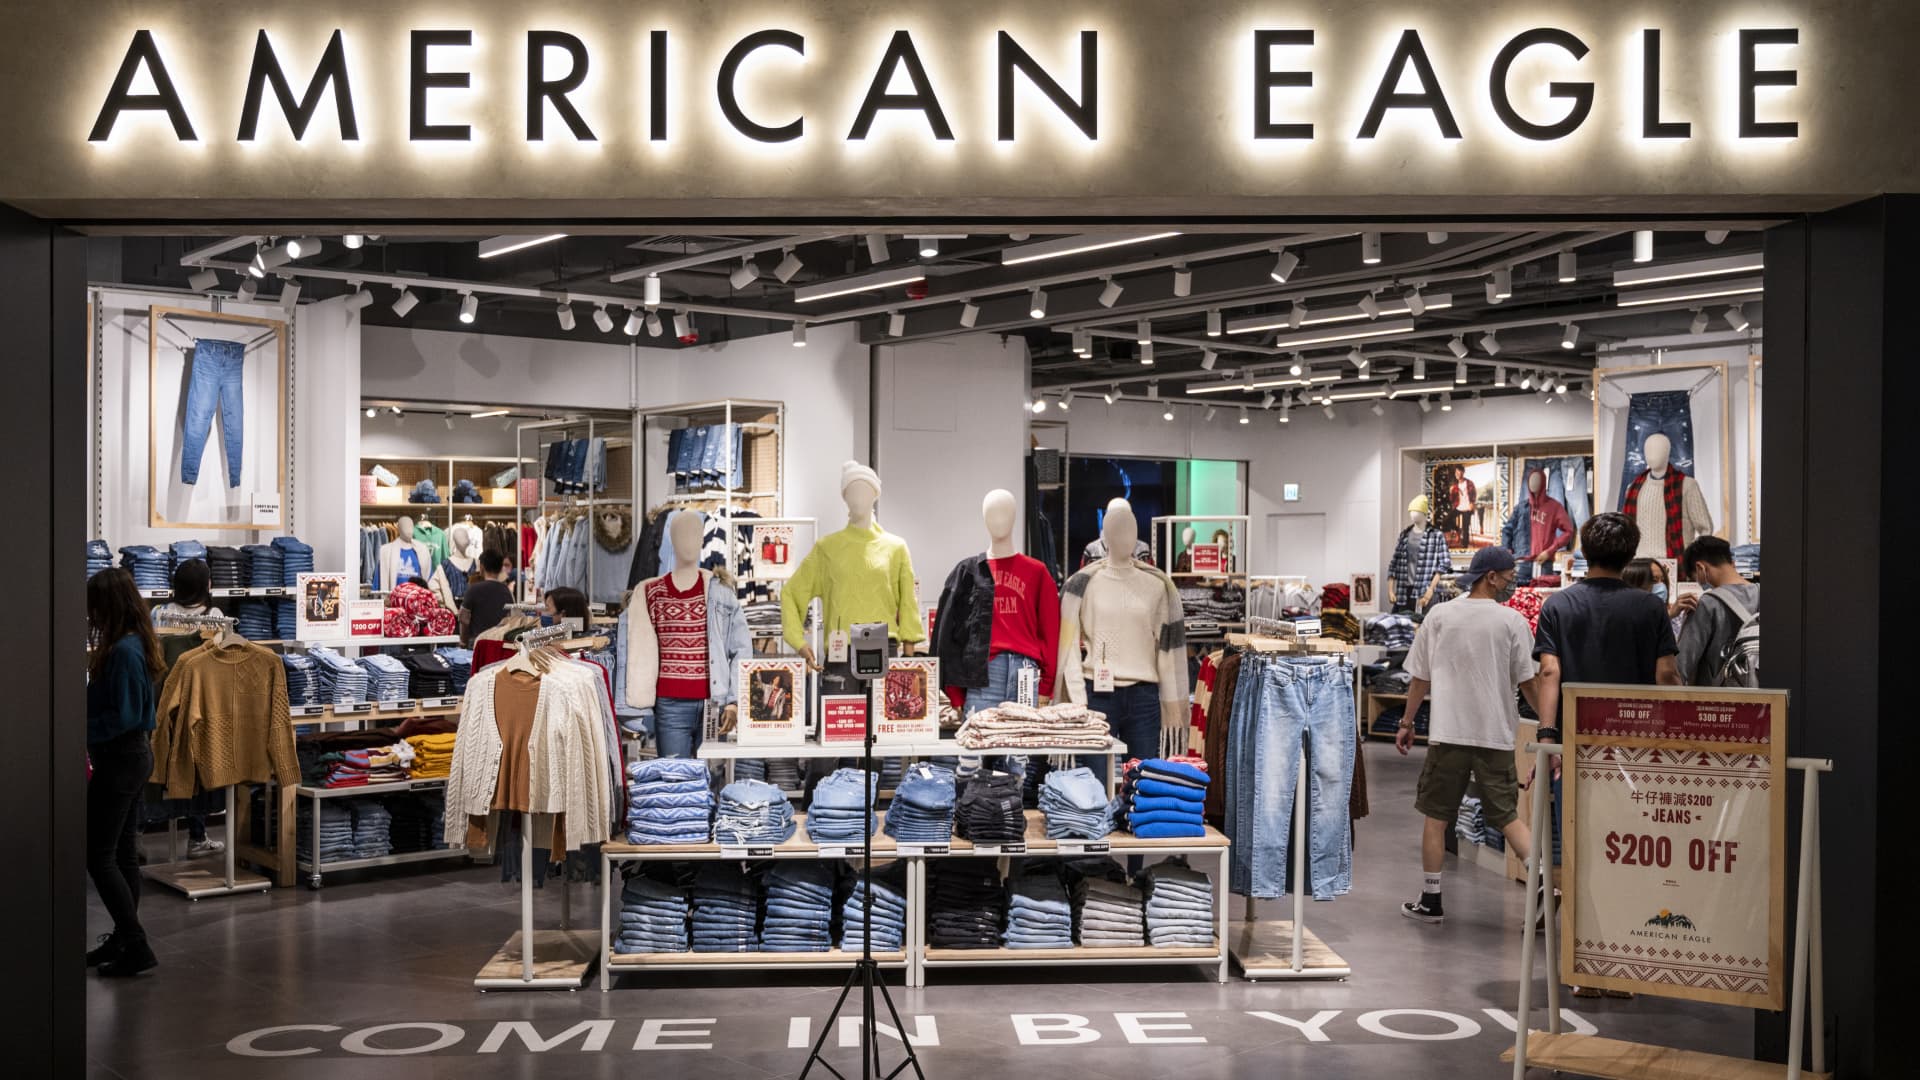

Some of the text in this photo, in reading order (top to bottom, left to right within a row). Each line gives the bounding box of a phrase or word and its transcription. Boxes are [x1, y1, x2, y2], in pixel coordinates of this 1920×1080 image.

[88, 28, 1799, 142] AMERICAN EAGLE
[1003, 571, 1026, 600] EAGLE
[1638, 710, 1650, 719] OFF
[1719, 713, 1733, 722] OFF
[878, 724, 894, 733] FREE
[1651, 808, 1692, 825] JEANS
[1605, 830, 1738, 873] $200 OFF
[1630, 929, 1711, 944] AMERICAN EAGLE
[225, 1008, 1599, 1057] COME IN BE YOU
